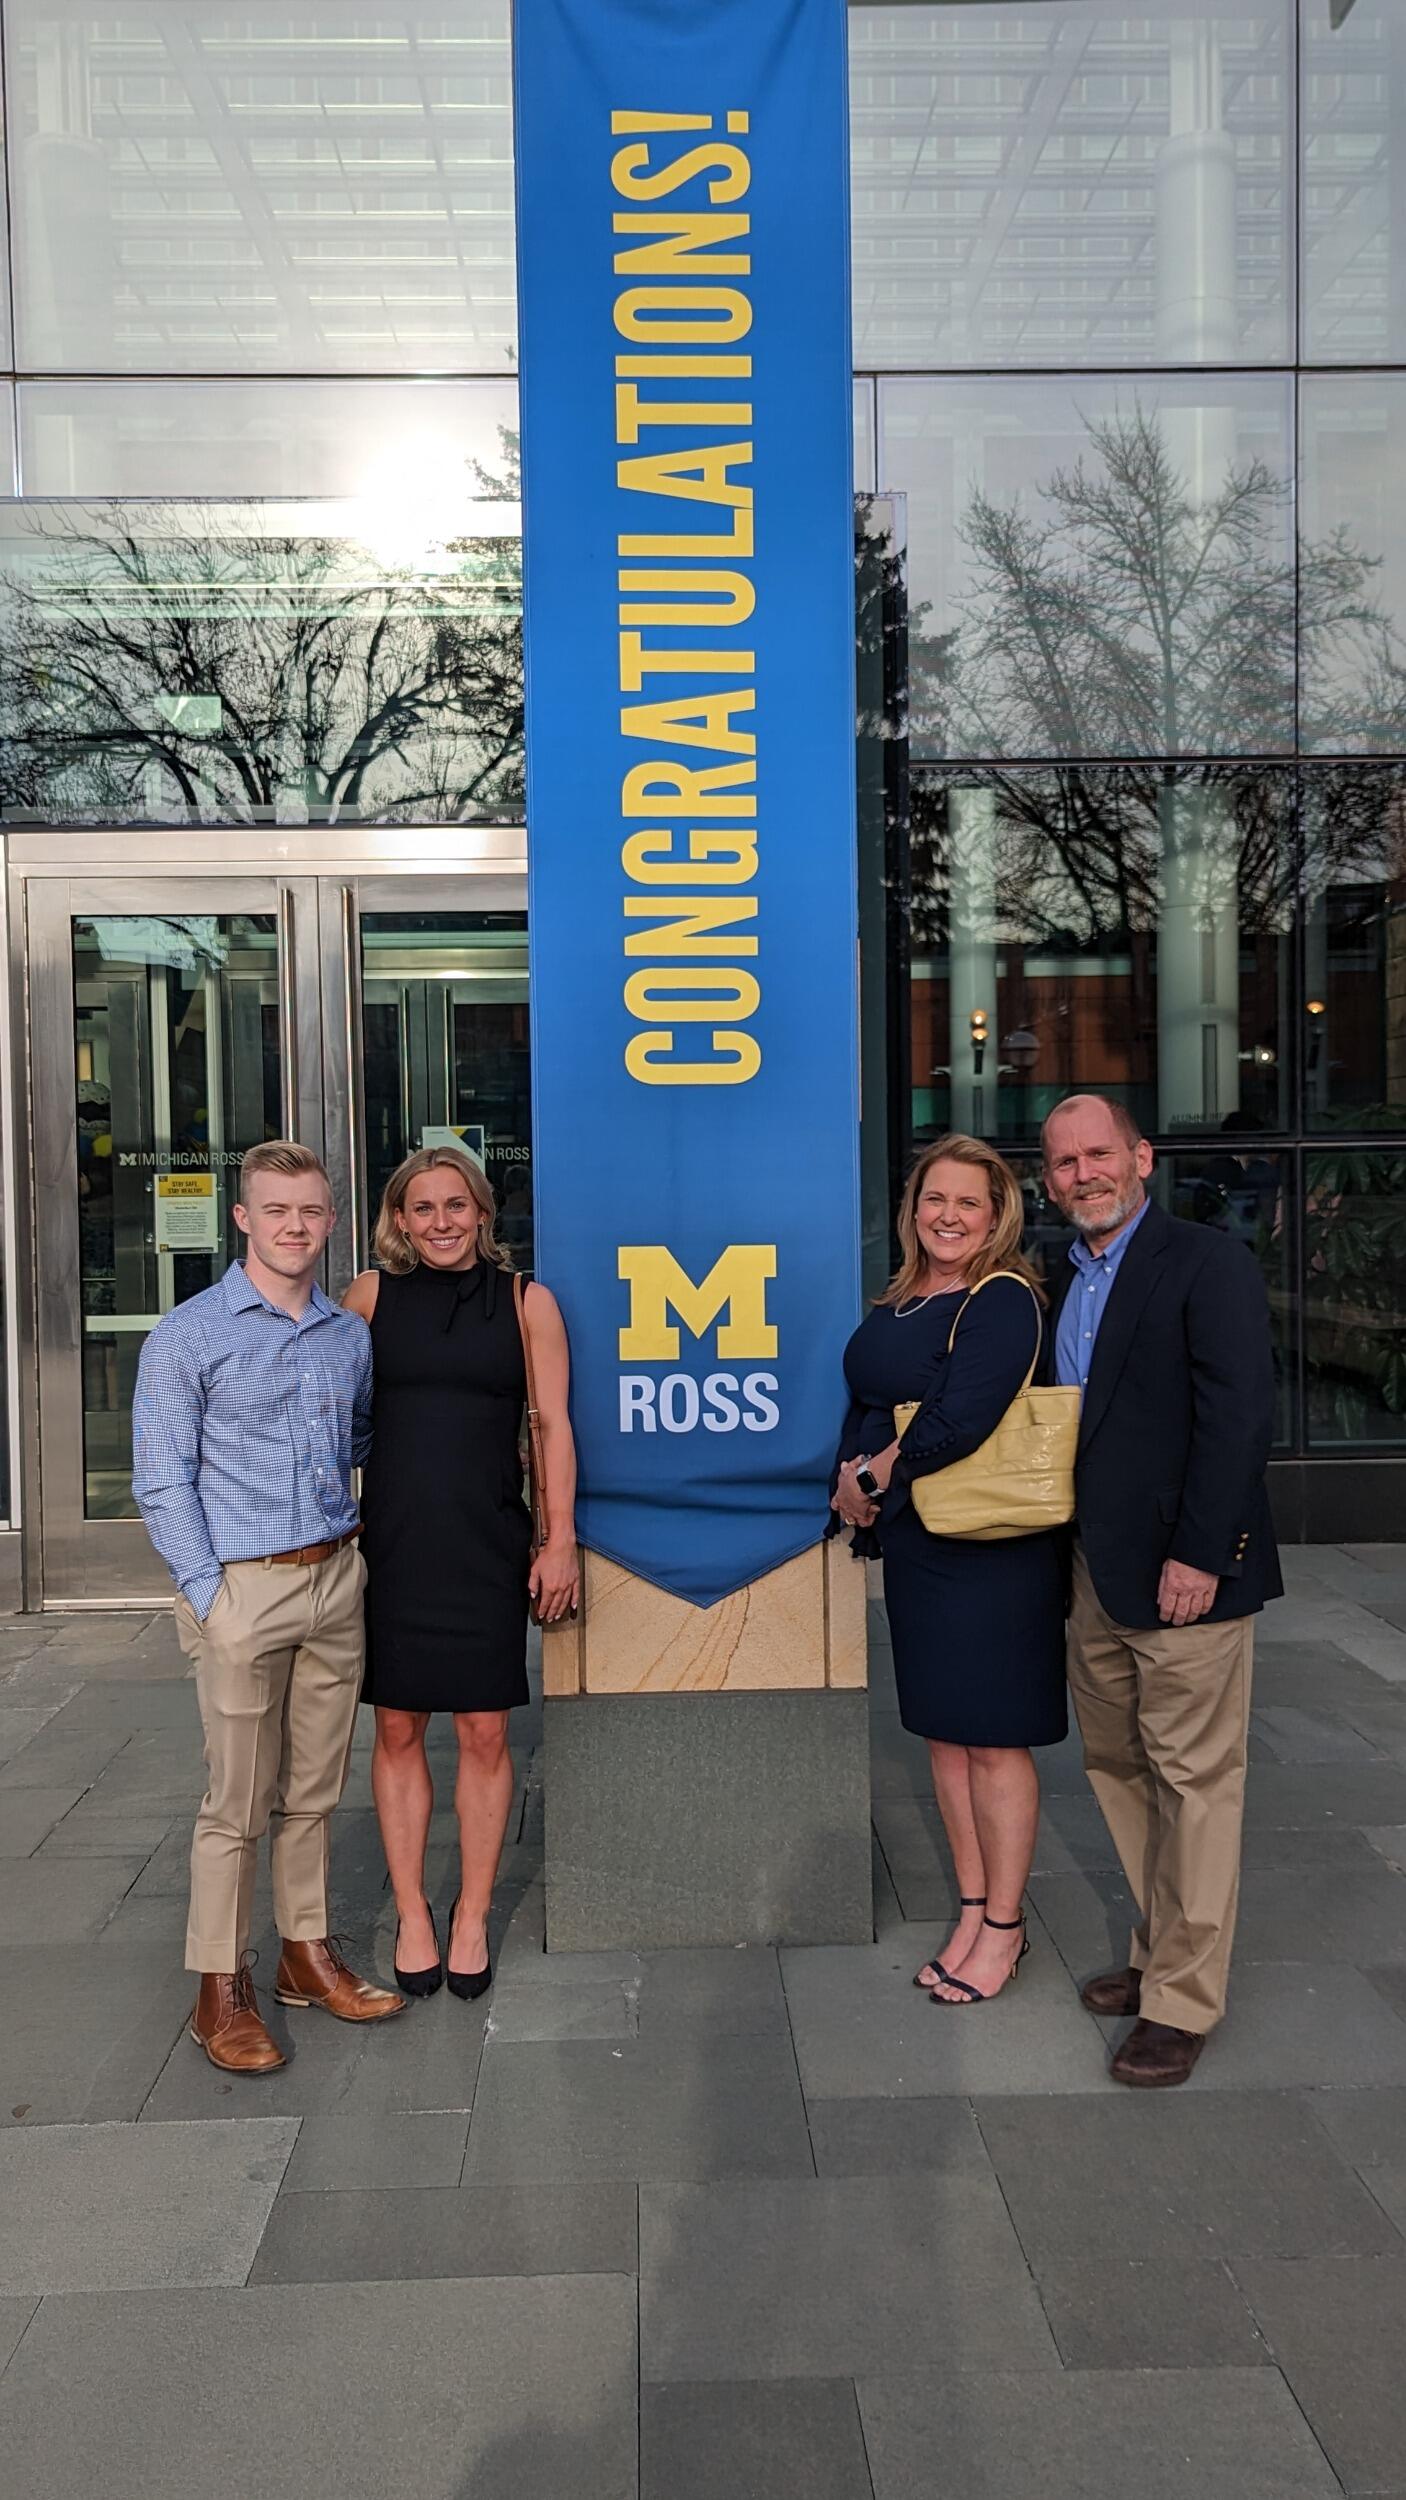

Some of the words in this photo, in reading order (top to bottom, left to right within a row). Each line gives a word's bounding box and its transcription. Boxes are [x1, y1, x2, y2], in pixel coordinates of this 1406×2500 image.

[611, 110, 761, 1085] CONGRATULATIONS!
[143, 1152, 209, 1166] MICHIGAN
[211, 1152, 245, 1165] ROSS
[497, 1147, 530, 1160] ROSS
[618, 1245, 778, 1361] M
[620, 1372, 780, 1433] ROSS
